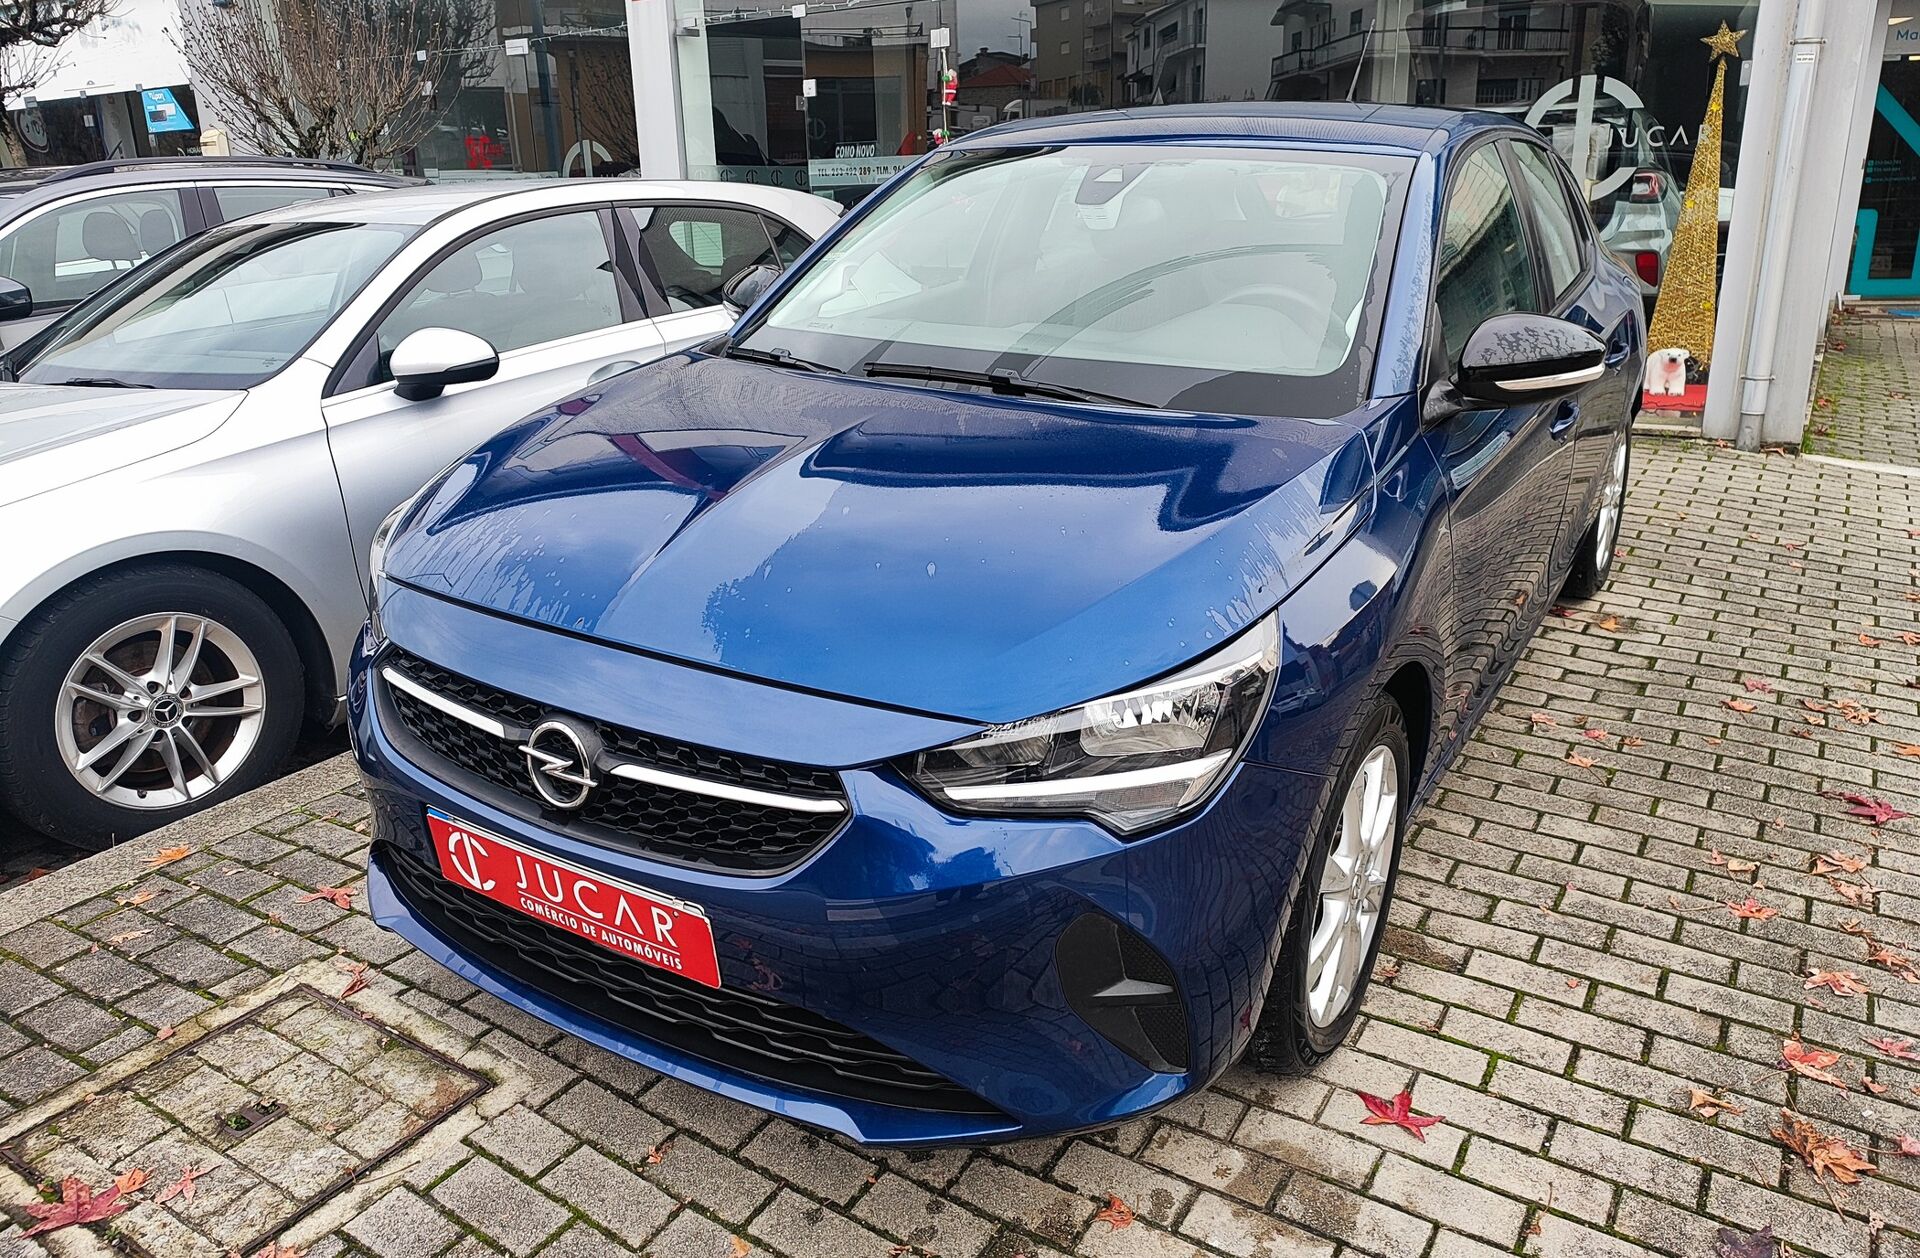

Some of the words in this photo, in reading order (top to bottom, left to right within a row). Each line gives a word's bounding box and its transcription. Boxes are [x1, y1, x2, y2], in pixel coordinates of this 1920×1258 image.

[1896, 29, 1920, 41] Ma
[835, 145, 855, 159] COMO
[856, 144, 875, 158] NOVO
[859, 165, 871, 176] 289
[515, 855, 679, 948] JUCAR
[520, 896, 578, 930] COMÉRCIO
[582, 921, 597, 938] DE
[601, 929, 683, 970] AUTOMÓVEIS
